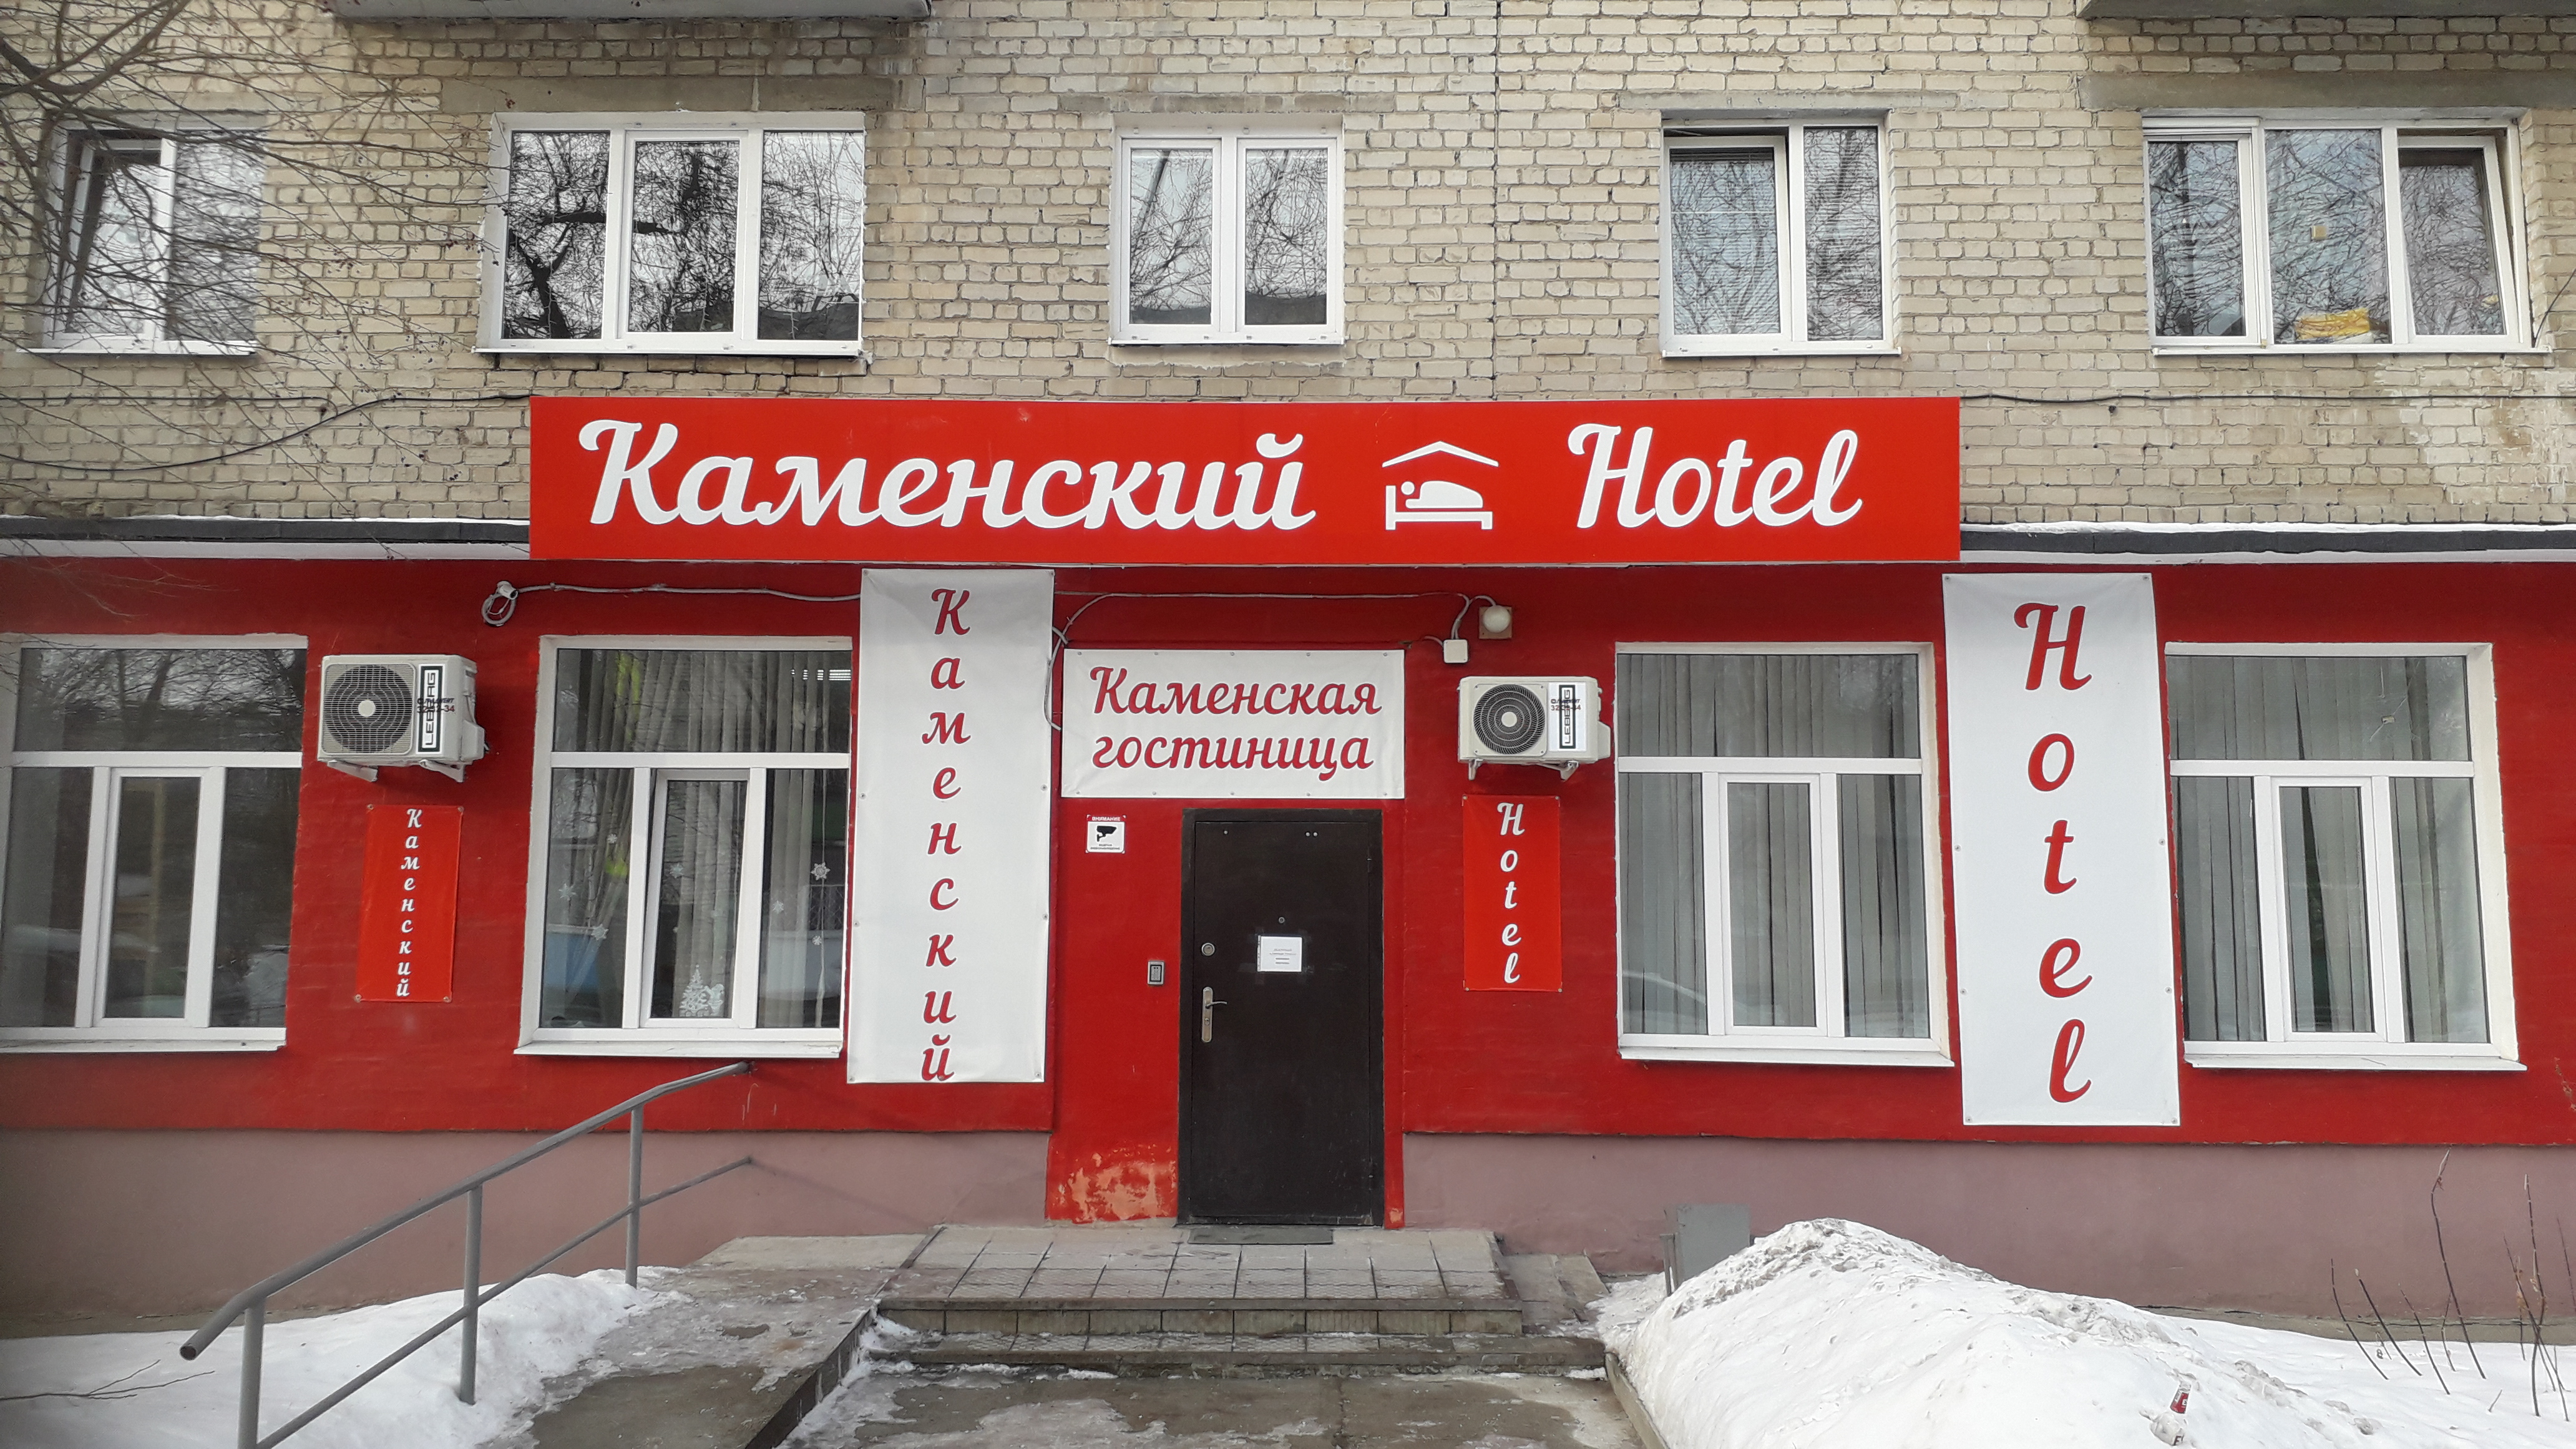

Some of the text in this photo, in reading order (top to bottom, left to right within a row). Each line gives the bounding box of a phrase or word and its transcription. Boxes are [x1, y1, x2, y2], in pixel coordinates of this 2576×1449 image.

[578, 418, 1317, 531] Каменский
[1567, 422, 1863, 529] Hotel
[1090, 666, 1382, 715] Каменская
[1092, 736, 1374, 782] гостиница
[396, 808, 423, 997] Каменский
[921, 588, 970, 1081] Каменский
[1496, 802, 1526, 984] Hotel
[2013, 602, 2092, 1103] Hotel
